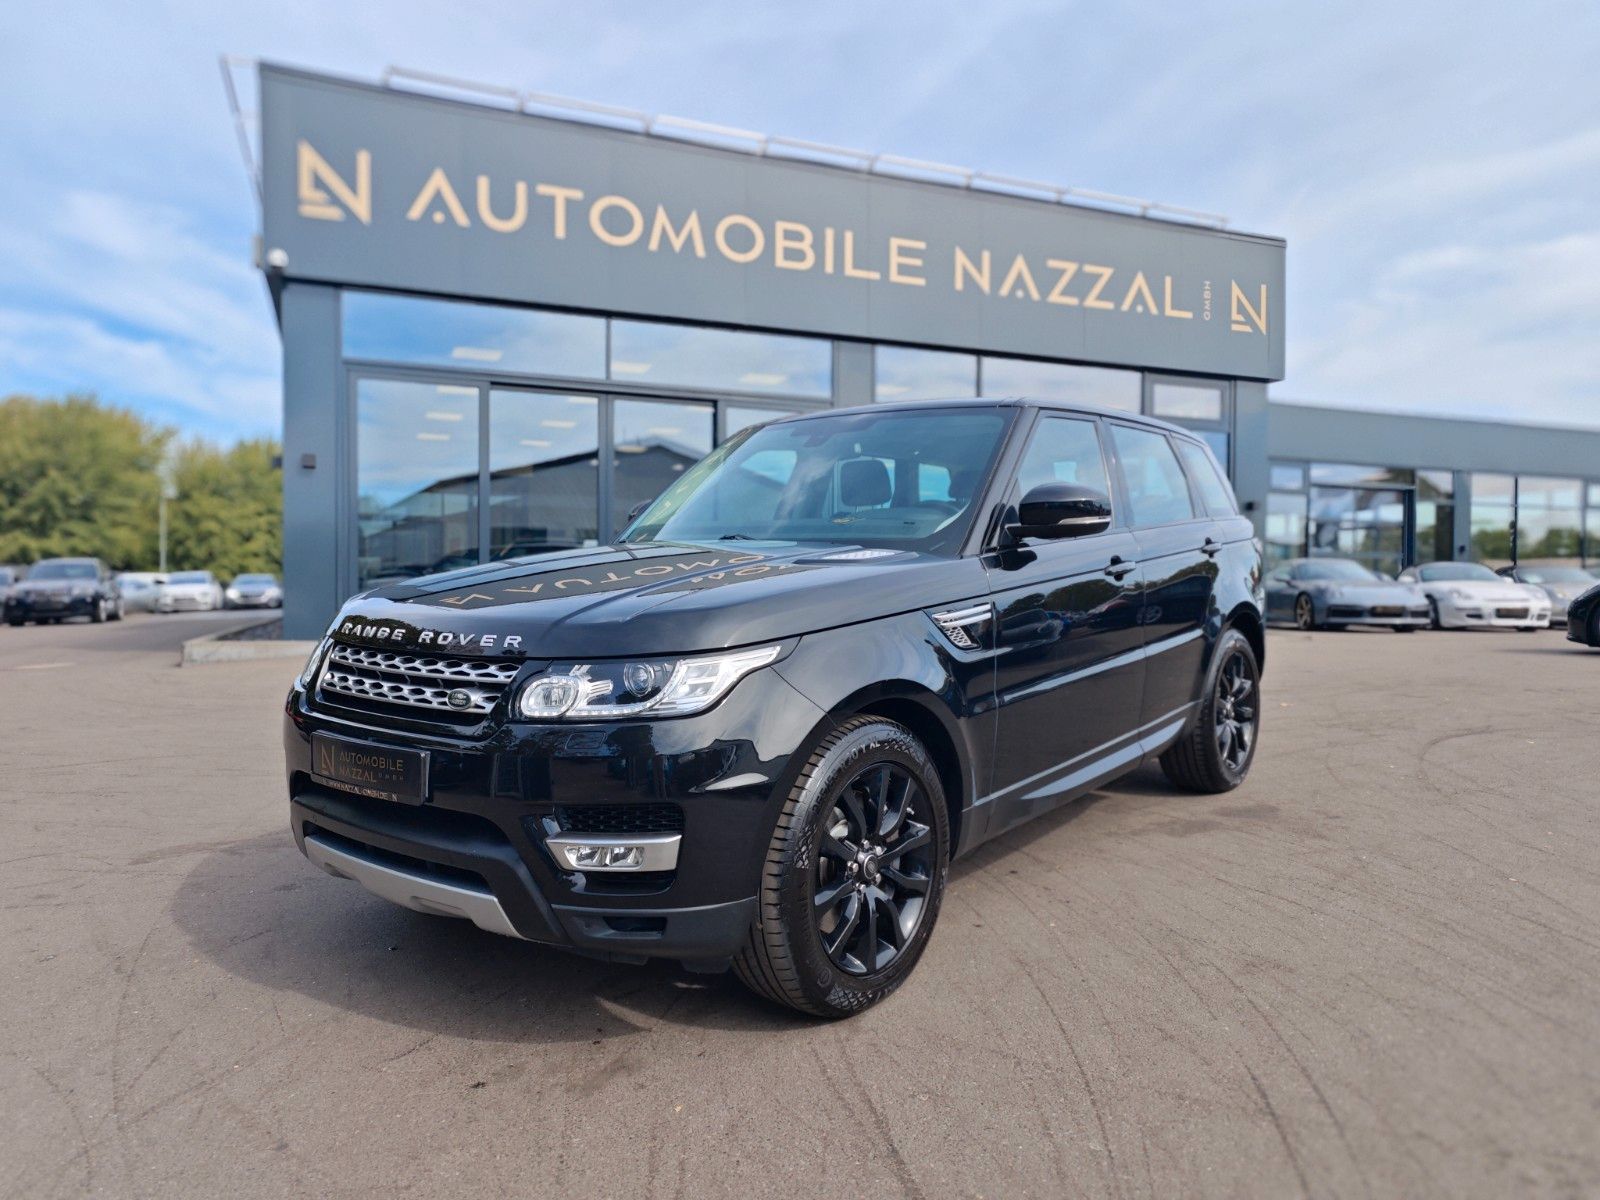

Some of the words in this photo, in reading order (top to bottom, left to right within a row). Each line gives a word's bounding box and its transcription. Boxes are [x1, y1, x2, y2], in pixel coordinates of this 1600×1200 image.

[406, 166, 927, 287] AUTOMOBILE
[953, 244, 1194, 320] NAZZAL
[1203, 280, 1212, 321] GMBH
[340, 622, 407, 641] RANGE
[418, 631, 523, 648] ROVER
[339, 751, 404, 772] AUTOMOBILE
[339, 765, 378, 783] NAZZAL
